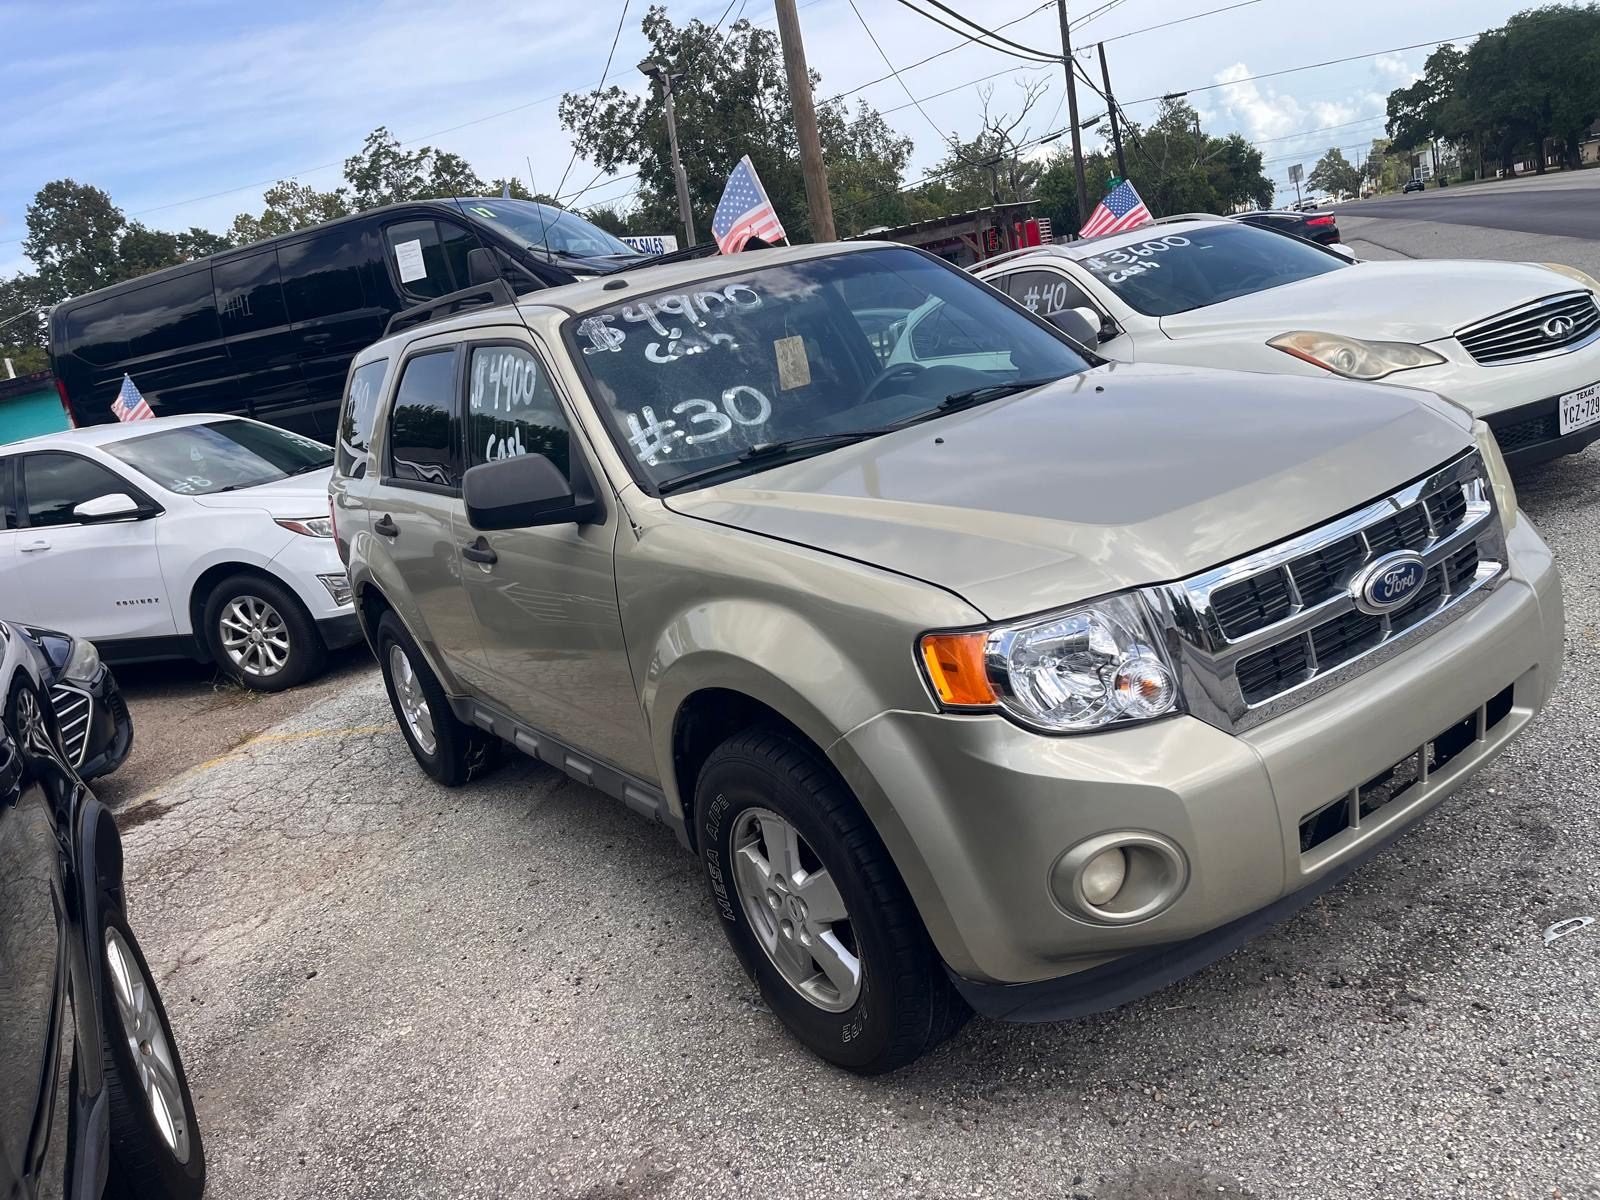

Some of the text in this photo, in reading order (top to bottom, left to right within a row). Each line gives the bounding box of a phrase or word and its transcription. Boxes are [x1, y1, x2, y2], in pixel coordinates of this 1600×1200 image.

[640, 238, 665, 255] SALES
[1023, 281, 1067, 314] #40
[1576, 387, 1595, 401] TEXAS
[627, 385, 772, 467] #30
[1384, 566, 1416, 598] Ford
[706, 848, 736, 921] MESA
